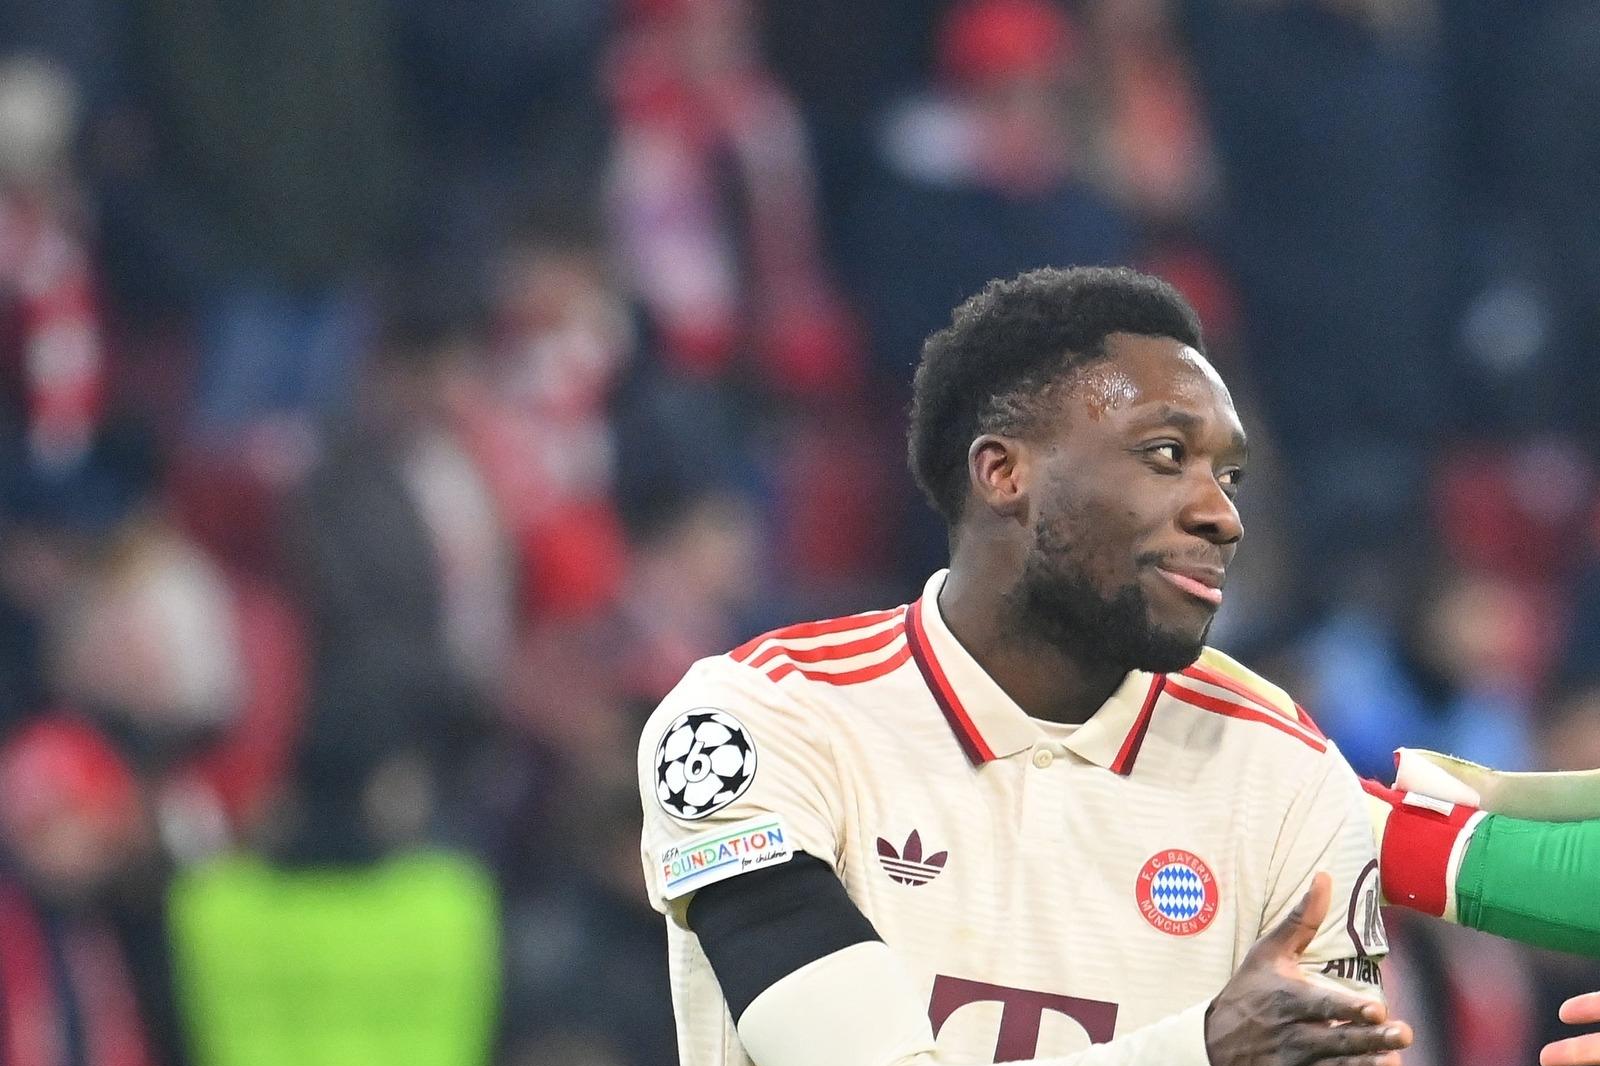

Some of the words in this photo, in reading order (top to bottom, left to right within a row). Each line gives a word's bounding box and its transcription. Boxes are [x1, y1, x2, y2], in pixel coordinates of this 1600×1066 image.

[661, 847, 680, 863] UEFA
[741, 856, 753, 872] for
[755, 848, 788, 864] children
[1167, 852, 1212, 883] BAYERN
